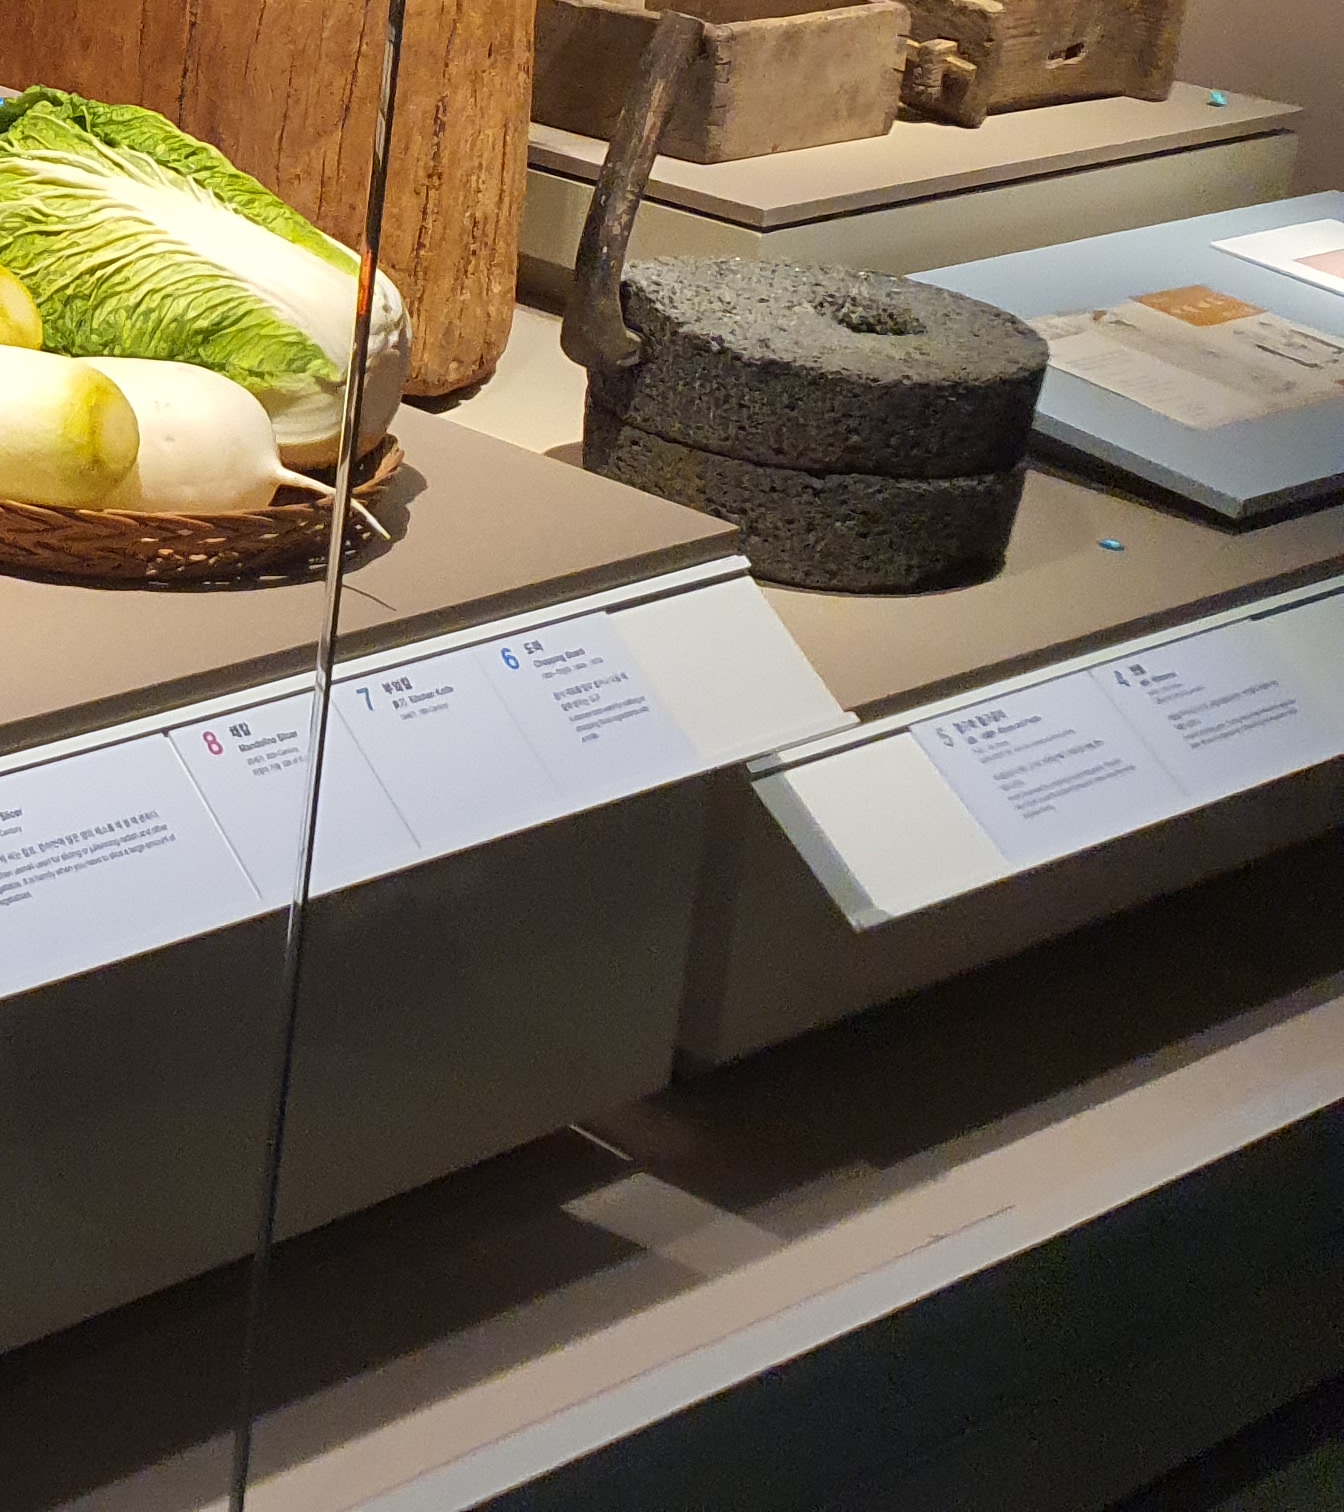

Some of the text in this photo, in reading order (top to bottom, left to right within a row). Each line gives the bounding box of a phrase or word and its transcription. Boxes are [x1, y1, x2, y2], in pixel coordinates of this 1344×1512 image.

[501, 647, 520, 670] 6
[355, 686, 373, 711] 7
[201, 730, 223, 755] 8
